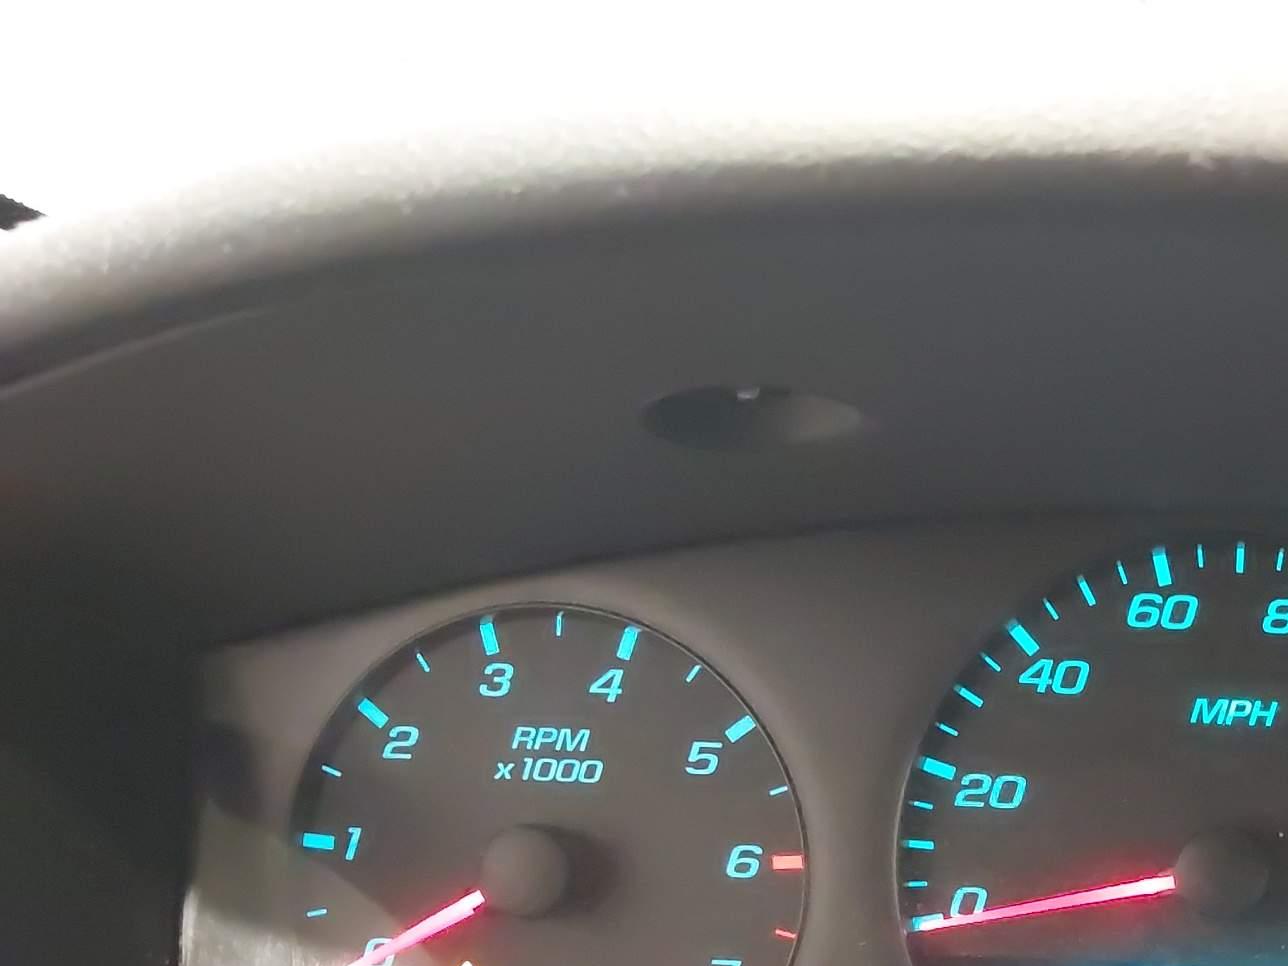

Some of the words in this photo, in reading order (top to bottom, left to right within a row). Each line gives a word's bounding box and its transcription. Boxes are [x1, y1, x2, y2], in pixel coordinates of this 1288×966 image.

[1126, 593, 1198, 630] 60
[480, 662, 514, 697] 3
[589, 668, 624, 703] 4
[1018, 658, 1090, 695] 40
[1189, 697, 1278, 727] MPH
[381, 725, 419, 760] 2
[511, 726, 590, 752] RPM
[684, 741, 723, 776] 5
[953, 773, 1027, 809] 20
[344, 827, 362, 860] 1
[725, 844, 763, 879] 6
[950, 886, 988, 919] 0
